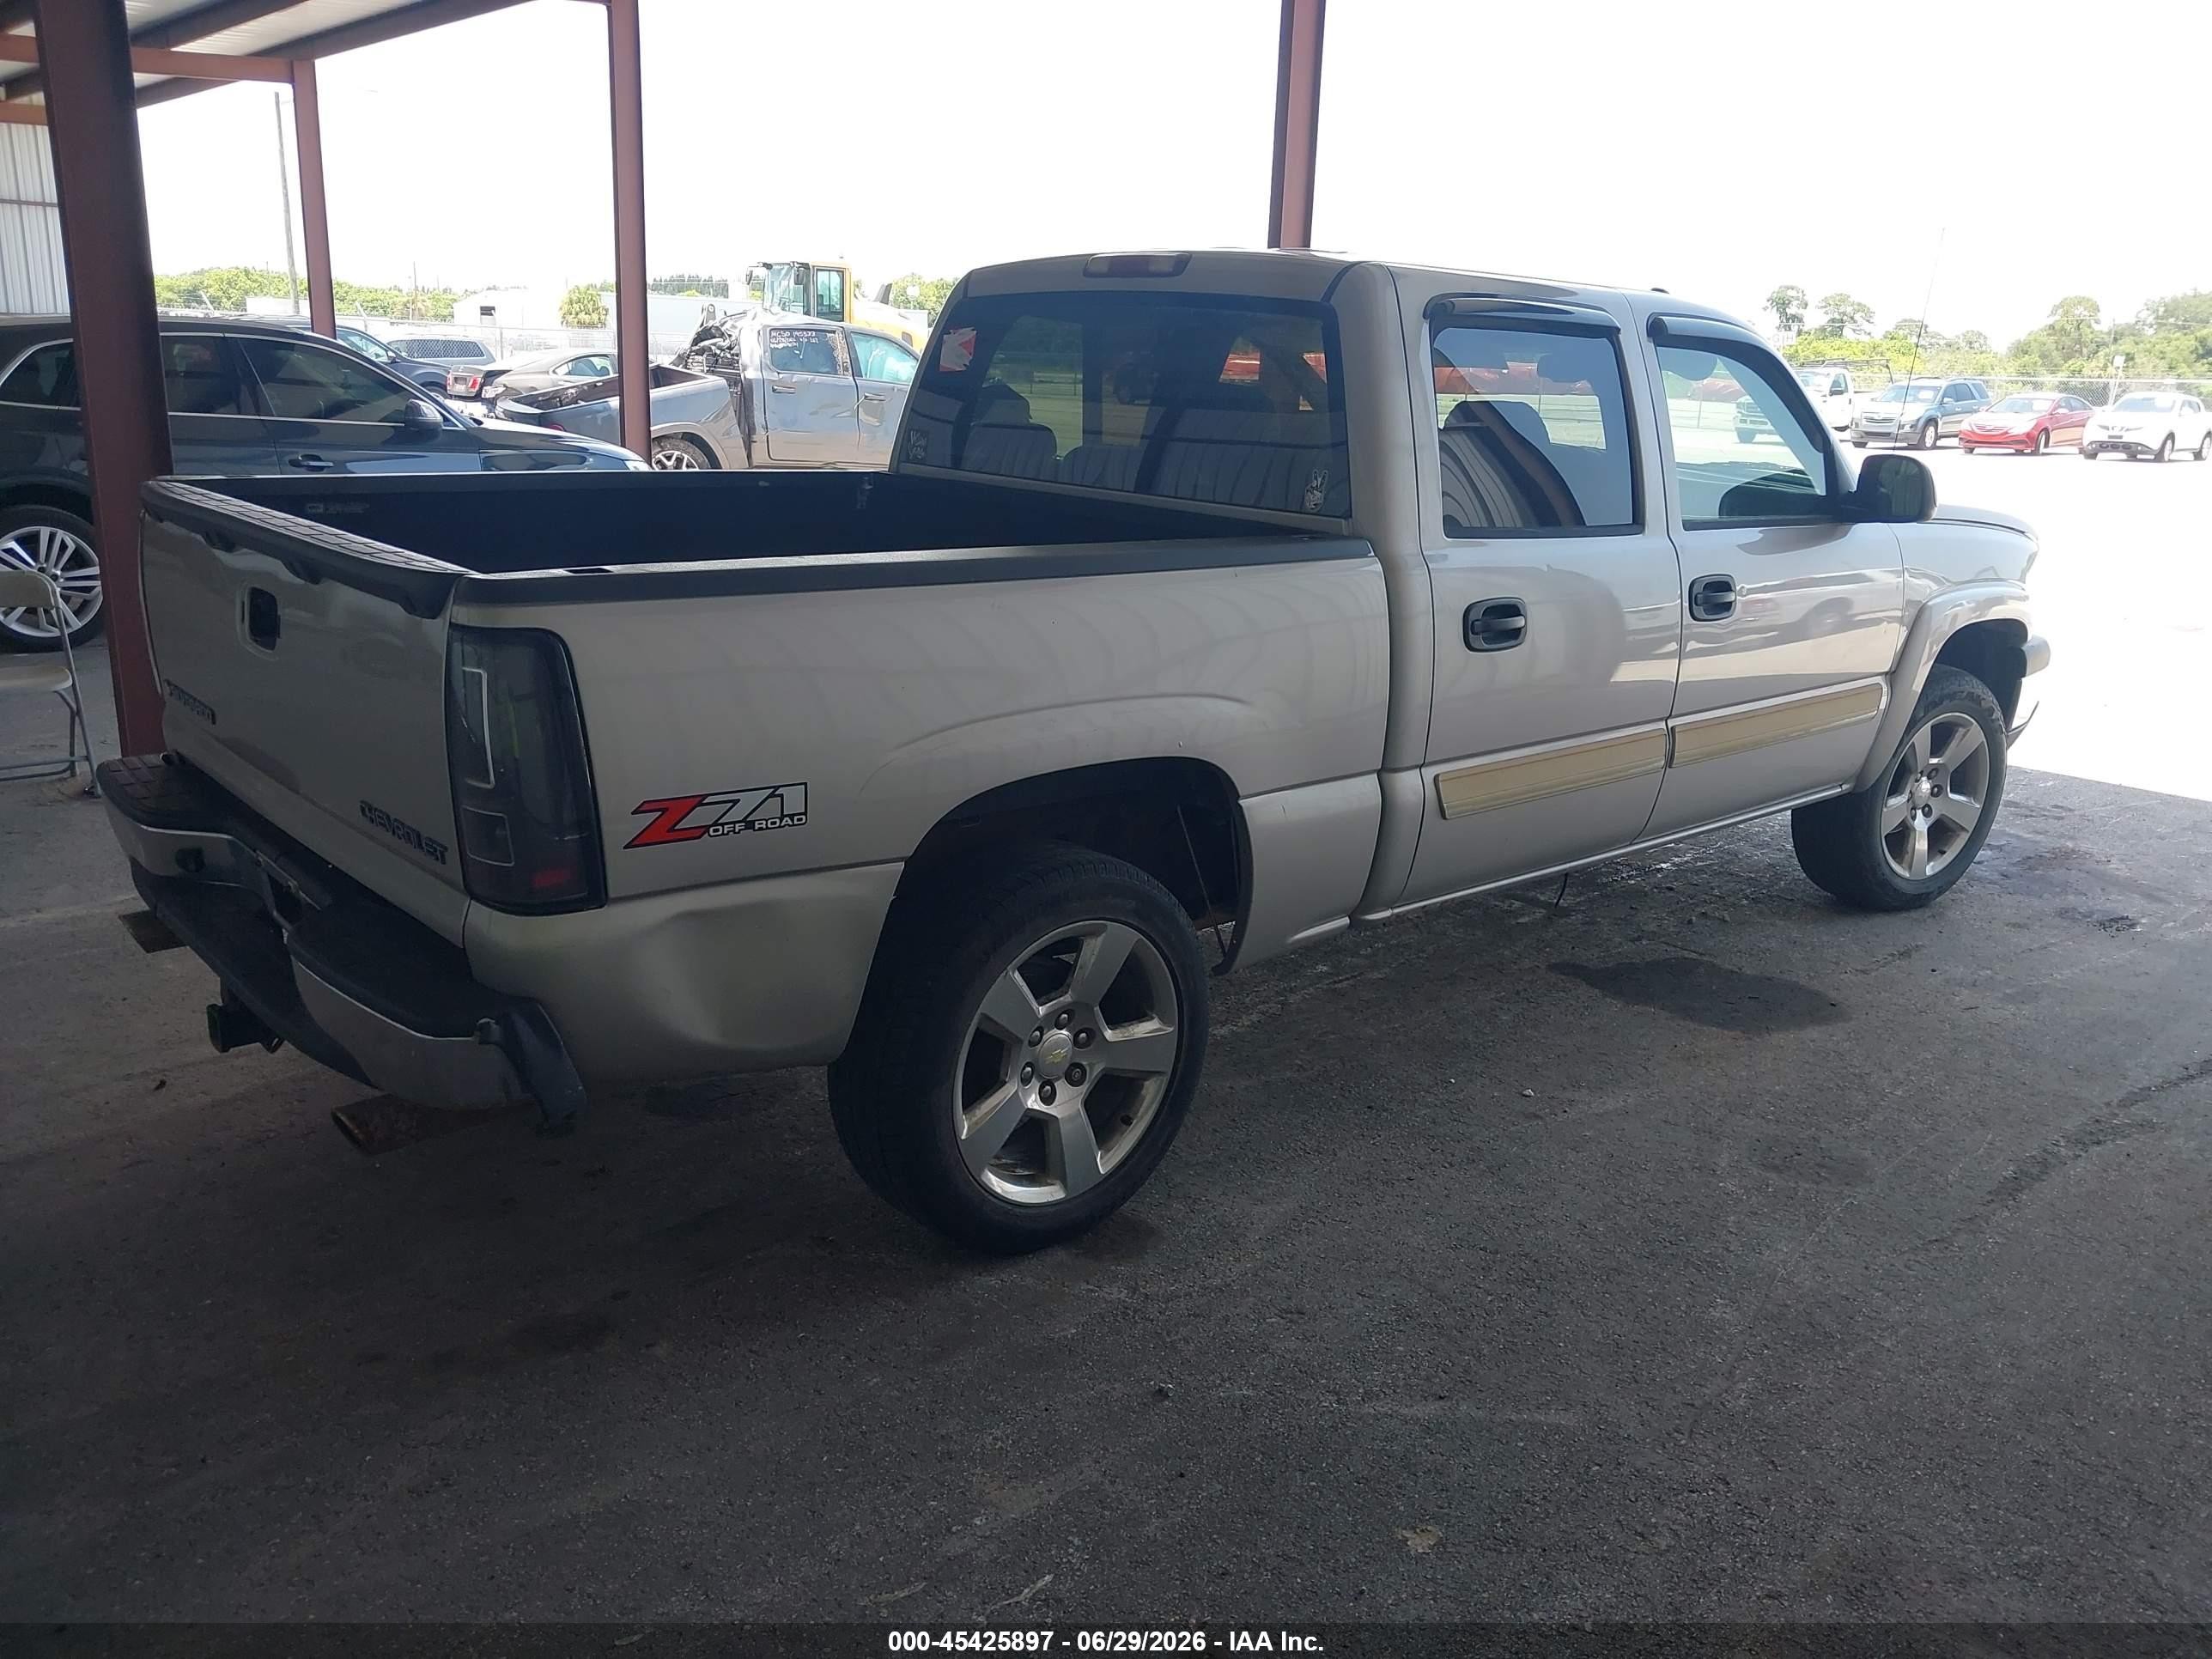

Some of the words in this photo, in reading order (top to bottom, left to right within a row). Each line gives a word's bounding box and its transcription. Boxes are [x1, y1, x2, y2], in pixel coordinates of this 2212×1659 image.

[359, 799, 448, 865] CHEVROLET
[623, 781, 808, 849] Z71
[708, 823, 746, 838] OFF
[754, 814, 808, 832] ROAD
